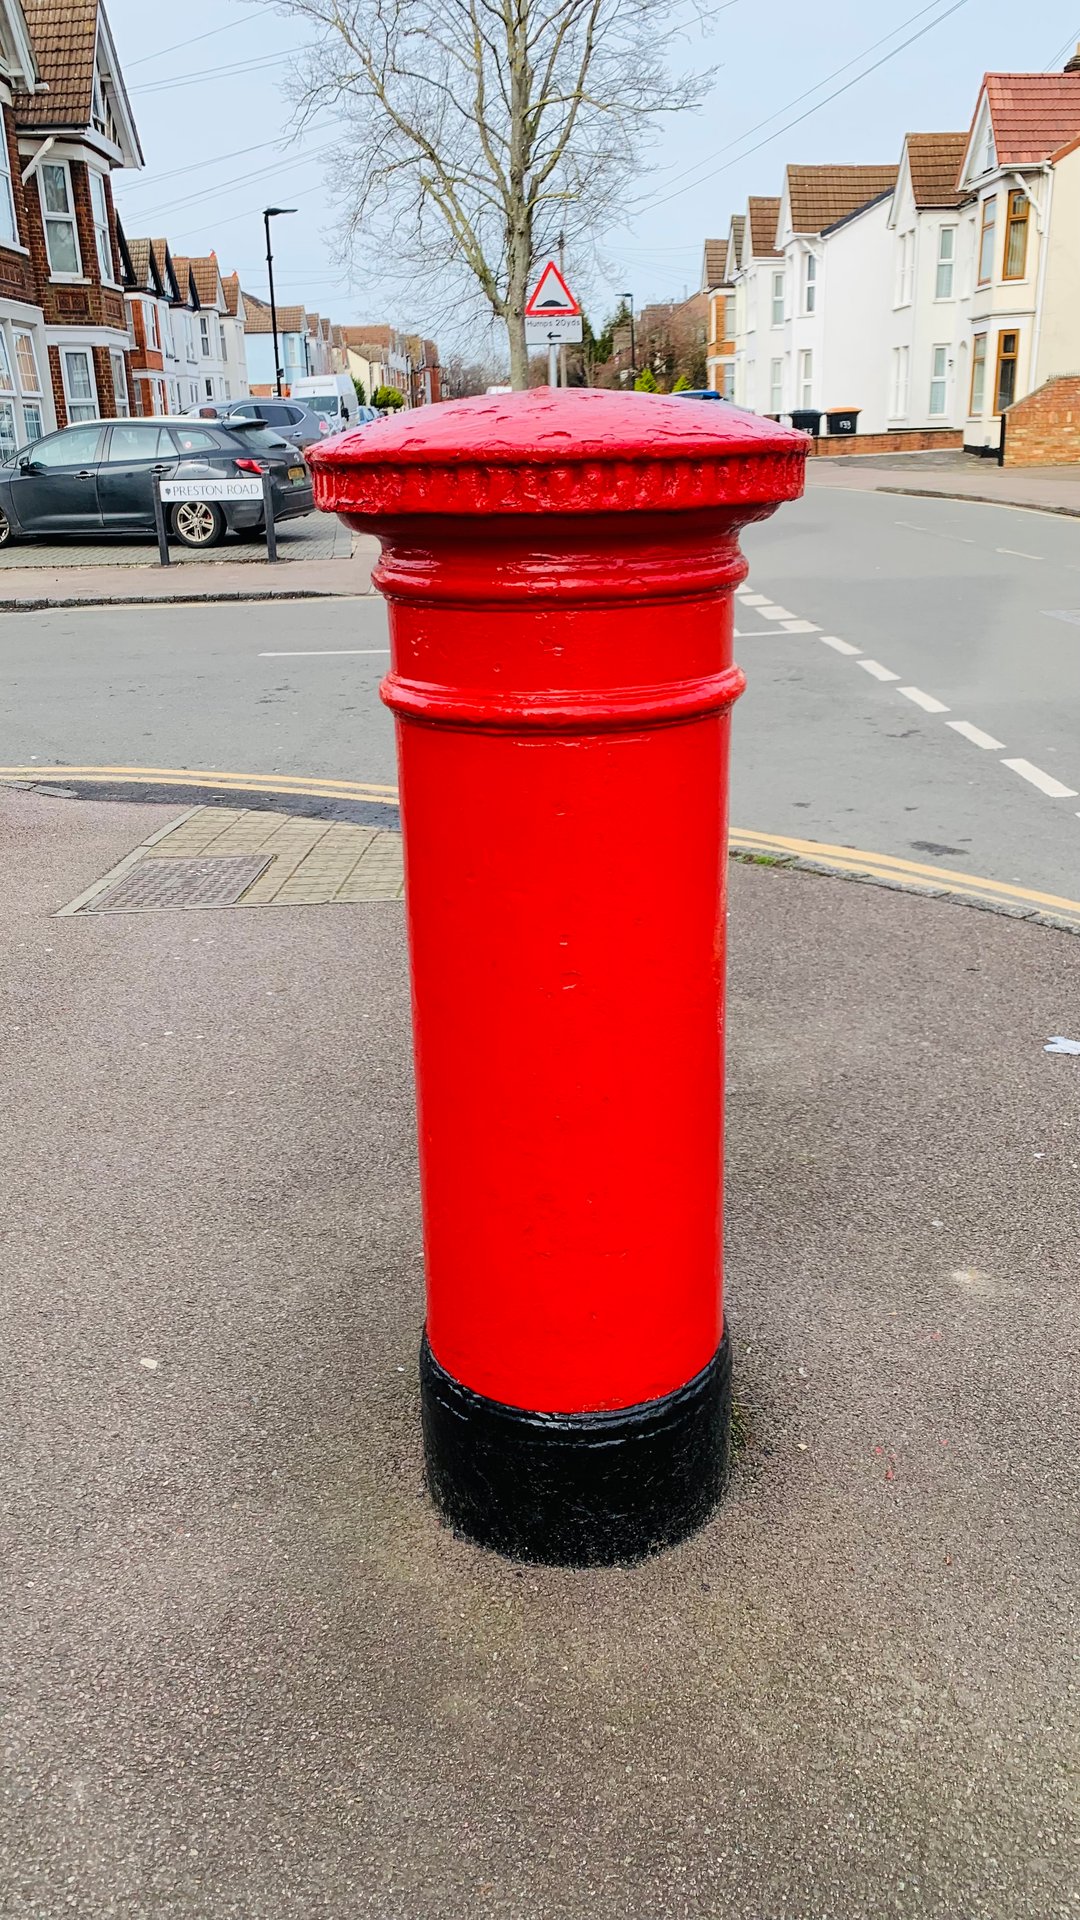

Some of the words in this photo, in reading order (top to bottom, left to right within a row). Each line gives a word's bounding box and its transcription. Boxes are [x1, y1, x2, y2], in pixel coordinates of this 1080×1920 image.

[526, 320, 553, 328] Humps
[172, 485, 223, 496] PRESTON
[226, 483, 259, 495] ROAD
